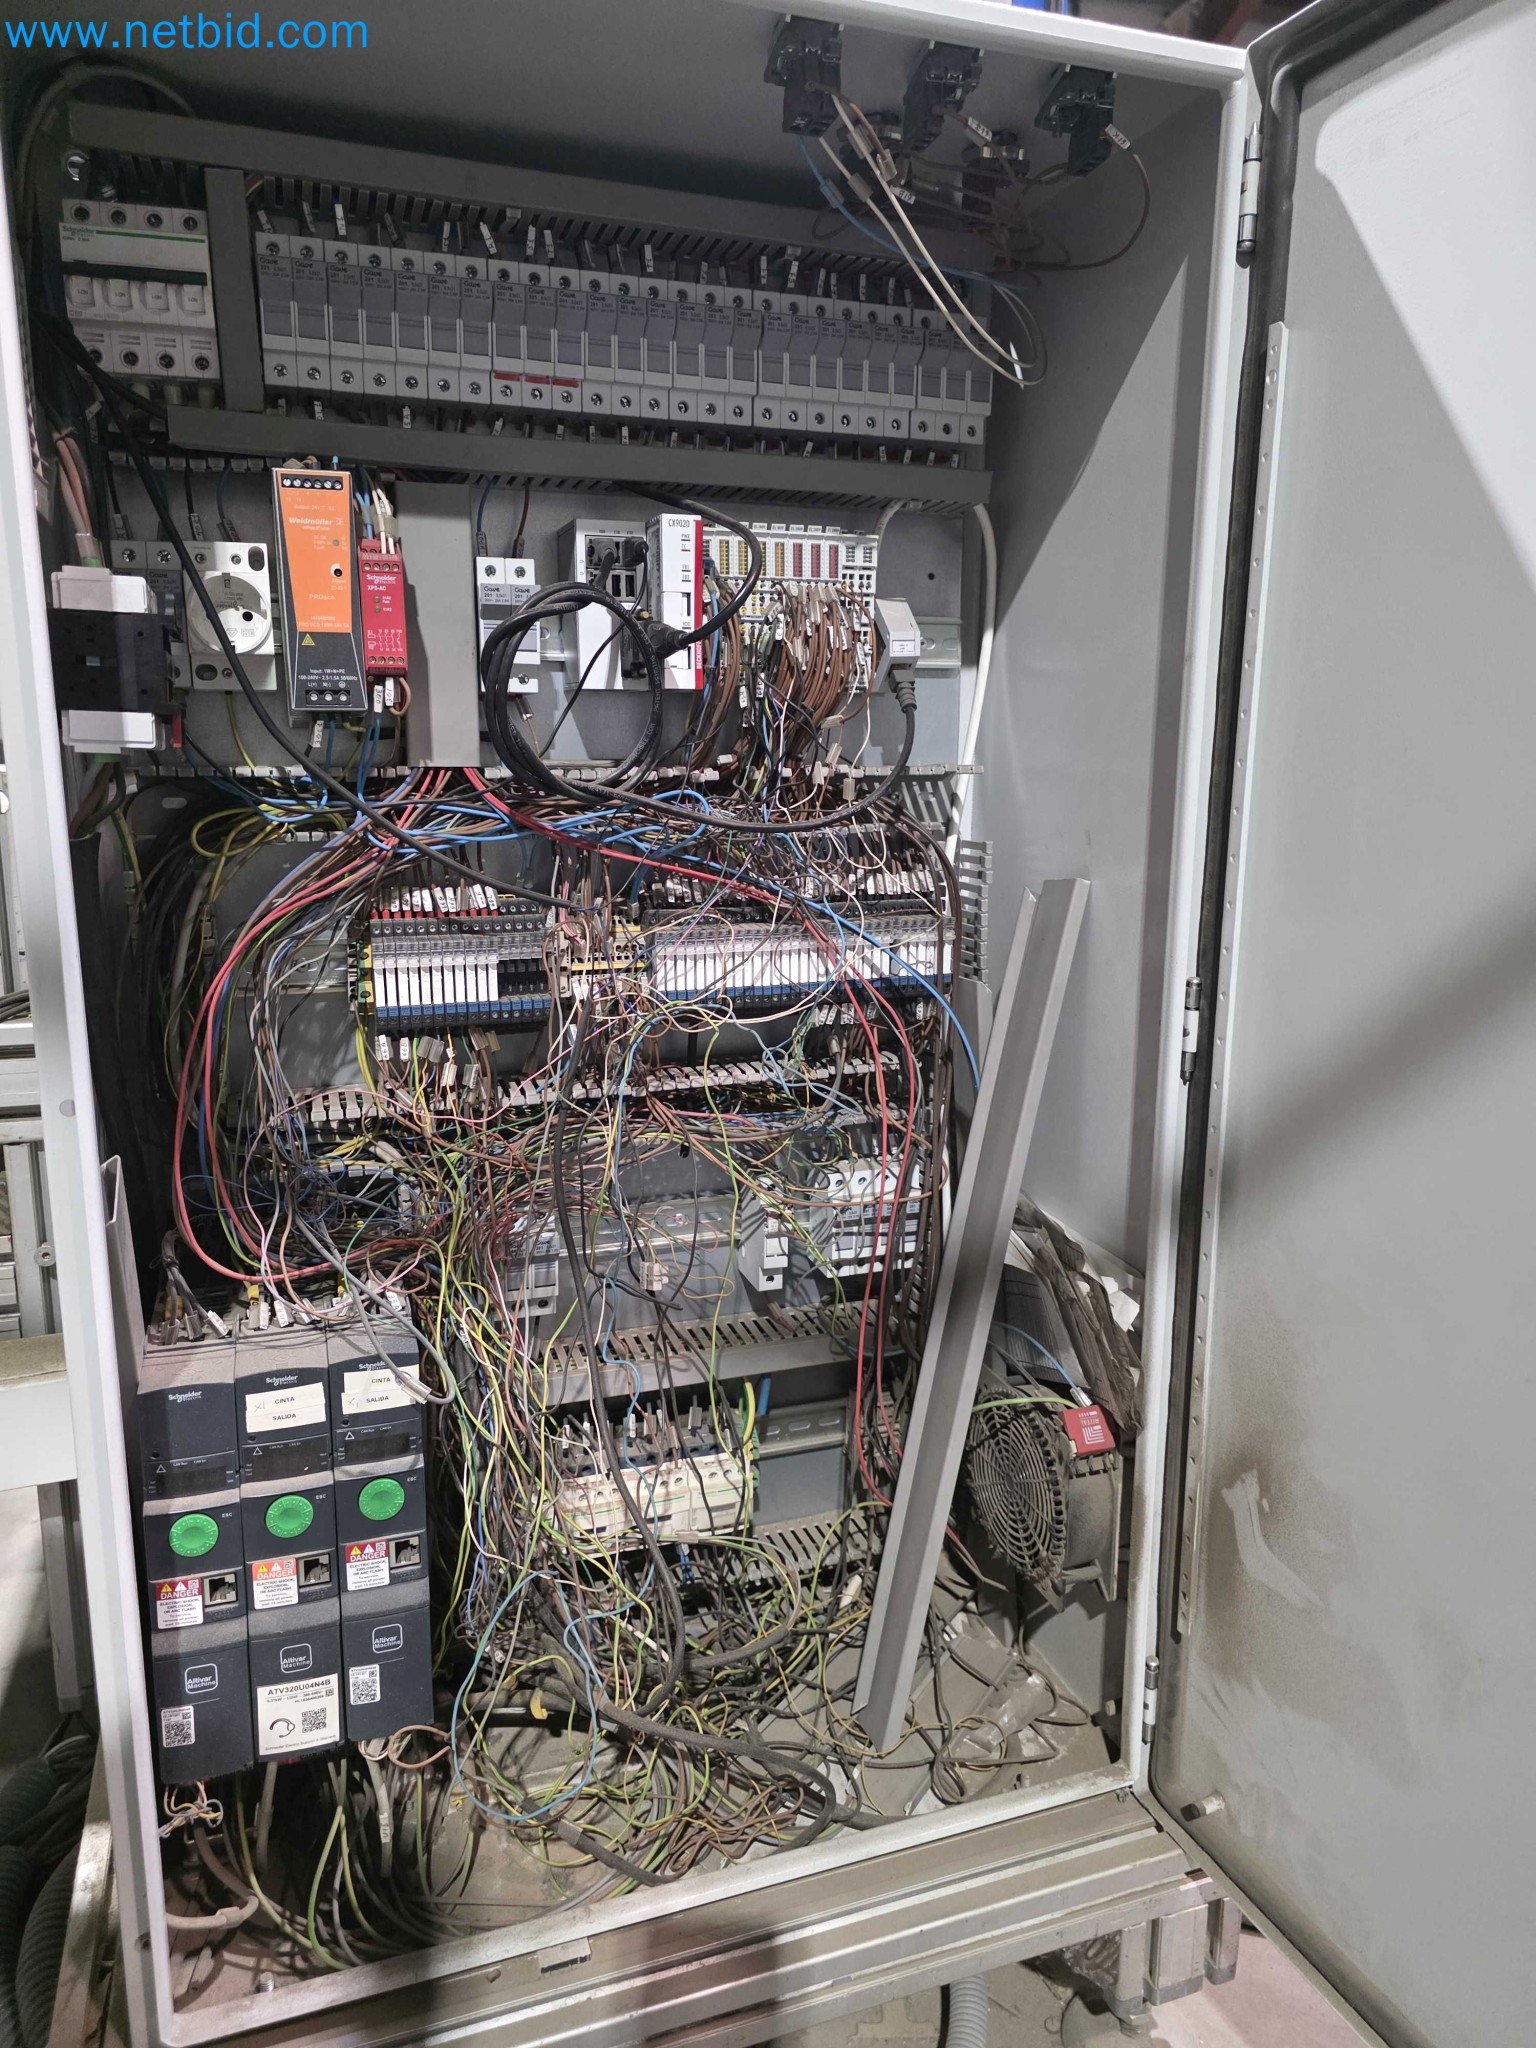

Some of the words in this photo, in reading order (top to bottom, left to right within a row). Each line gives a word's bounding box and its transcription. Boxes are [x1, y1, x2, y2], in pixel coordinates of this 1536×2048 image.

[288, 517, 332, 526] Weidmüller
[668, 519, 690, 528] CX9020
[366, 574, 396, 584] Schneider
[359, 1360, 386, 1371] Schneide
[266, 1375, 298, 1386] Schneider
[168, 1391, 202, 1402] Schneider
[275, 1396, 295, 1404] CINTA
[272, 1413, 296, 1421] SALIDA
[350, 1551, 386, 1562] DANGER
[257, 1570, 294, 1580] DANGER
[160, 1589, 199, 1600] DANGER
[374, 1635, 397, 1644] Altivar
[374, 1640, 400, 1648] Machine
[282, 1655, 306, 1664] Altivar
[187, 1676, 212, 1684] Altivar
[188, 1681, 216, 1689] Machine
[268, 1679, 331, 1695] ATV320U04N4B
